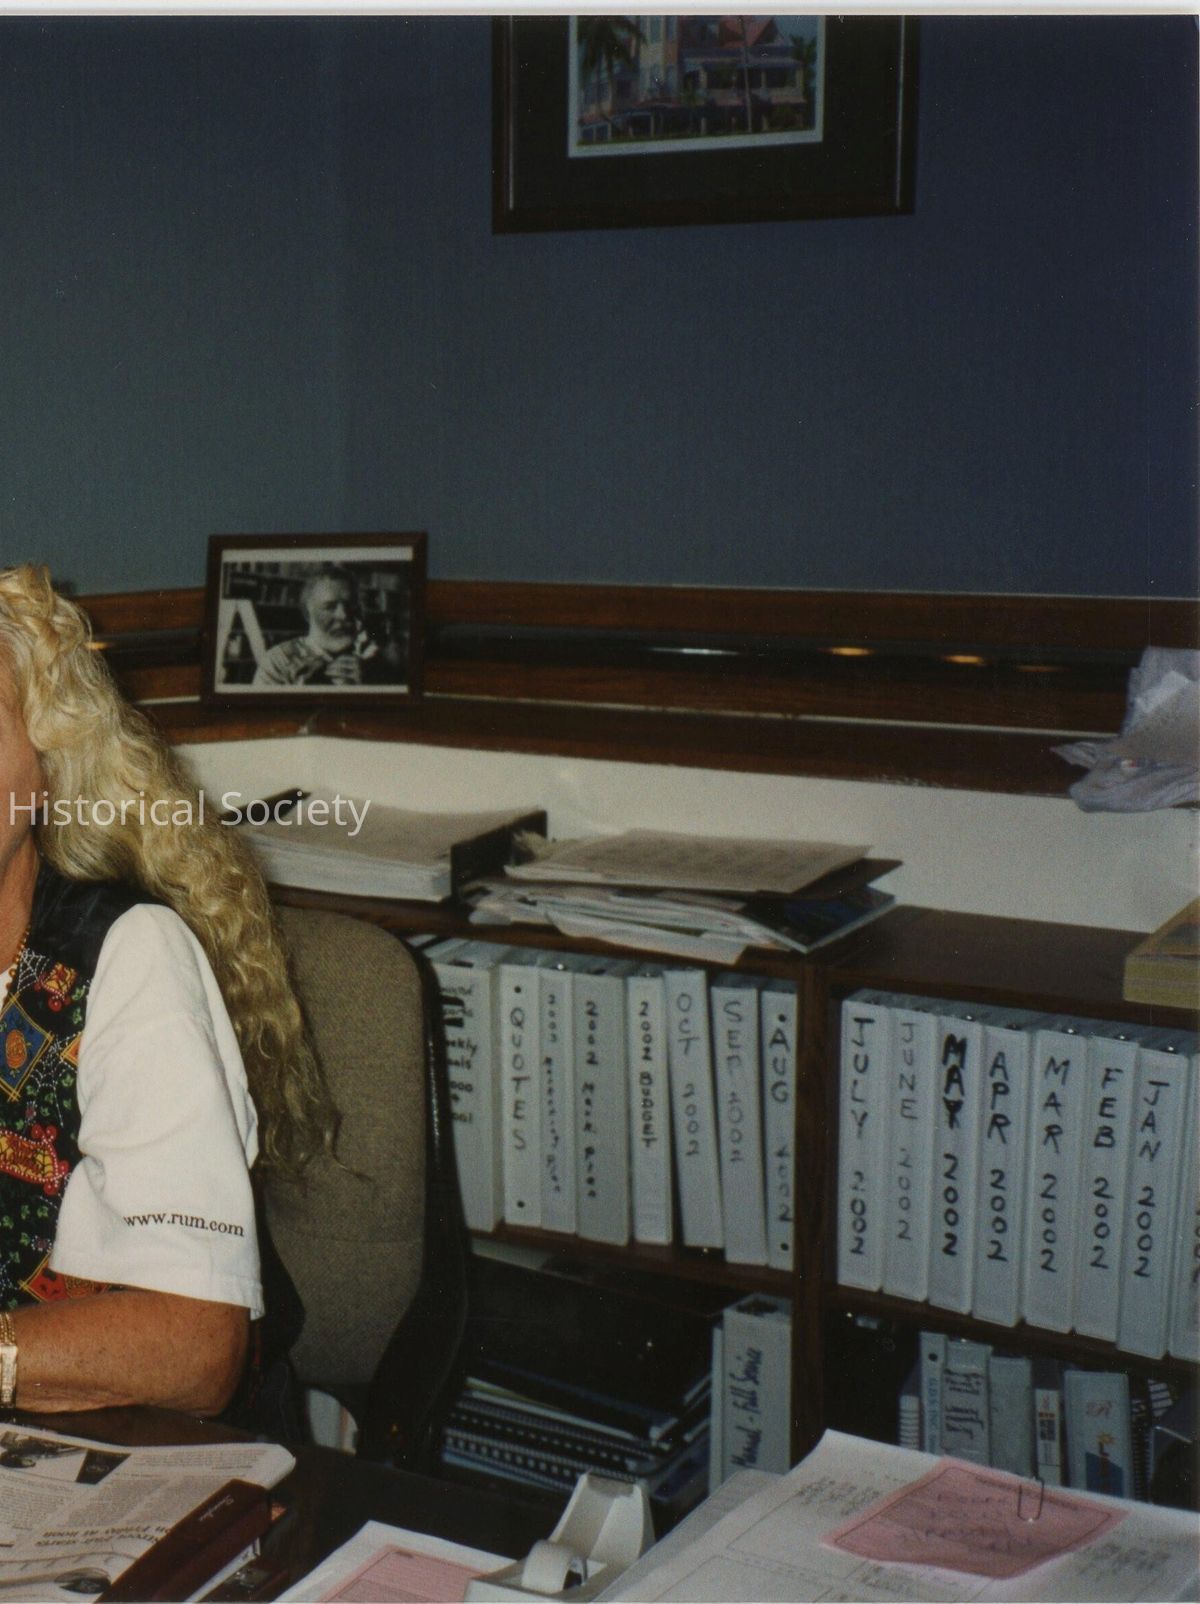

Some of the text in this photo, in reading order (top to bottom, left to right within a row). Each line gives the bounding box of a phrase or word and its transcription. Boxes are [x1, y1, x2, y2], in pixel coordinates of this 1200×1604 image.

[510, 1007, 530, 1150] QUOTES
[585, 1001, 599, 1065] 2002
[638, 1000, 654, 1063] 2002
[677, 993, 700, 1157] OCT 2002
[727, 1091, 745, 1163] 2002
[769, 1028, 793, 1222] AUG 2002
[123, 1212, 244, 1237] www.rum.com
[849, 1017, 875, 1256] JULY 2002
[898, 1022, 918, 1241] JUNE 2002
[941, 1033, 968, 1256] MAY 2002
[987, 1051, 1012, 1262] APR 2002
[1040, 1055, 1071, 1273] MAR 2002
[1090, 1067, 1124, 1270] FEB 2002
[1133, 1079, 1171, 1279] JAN 2002
